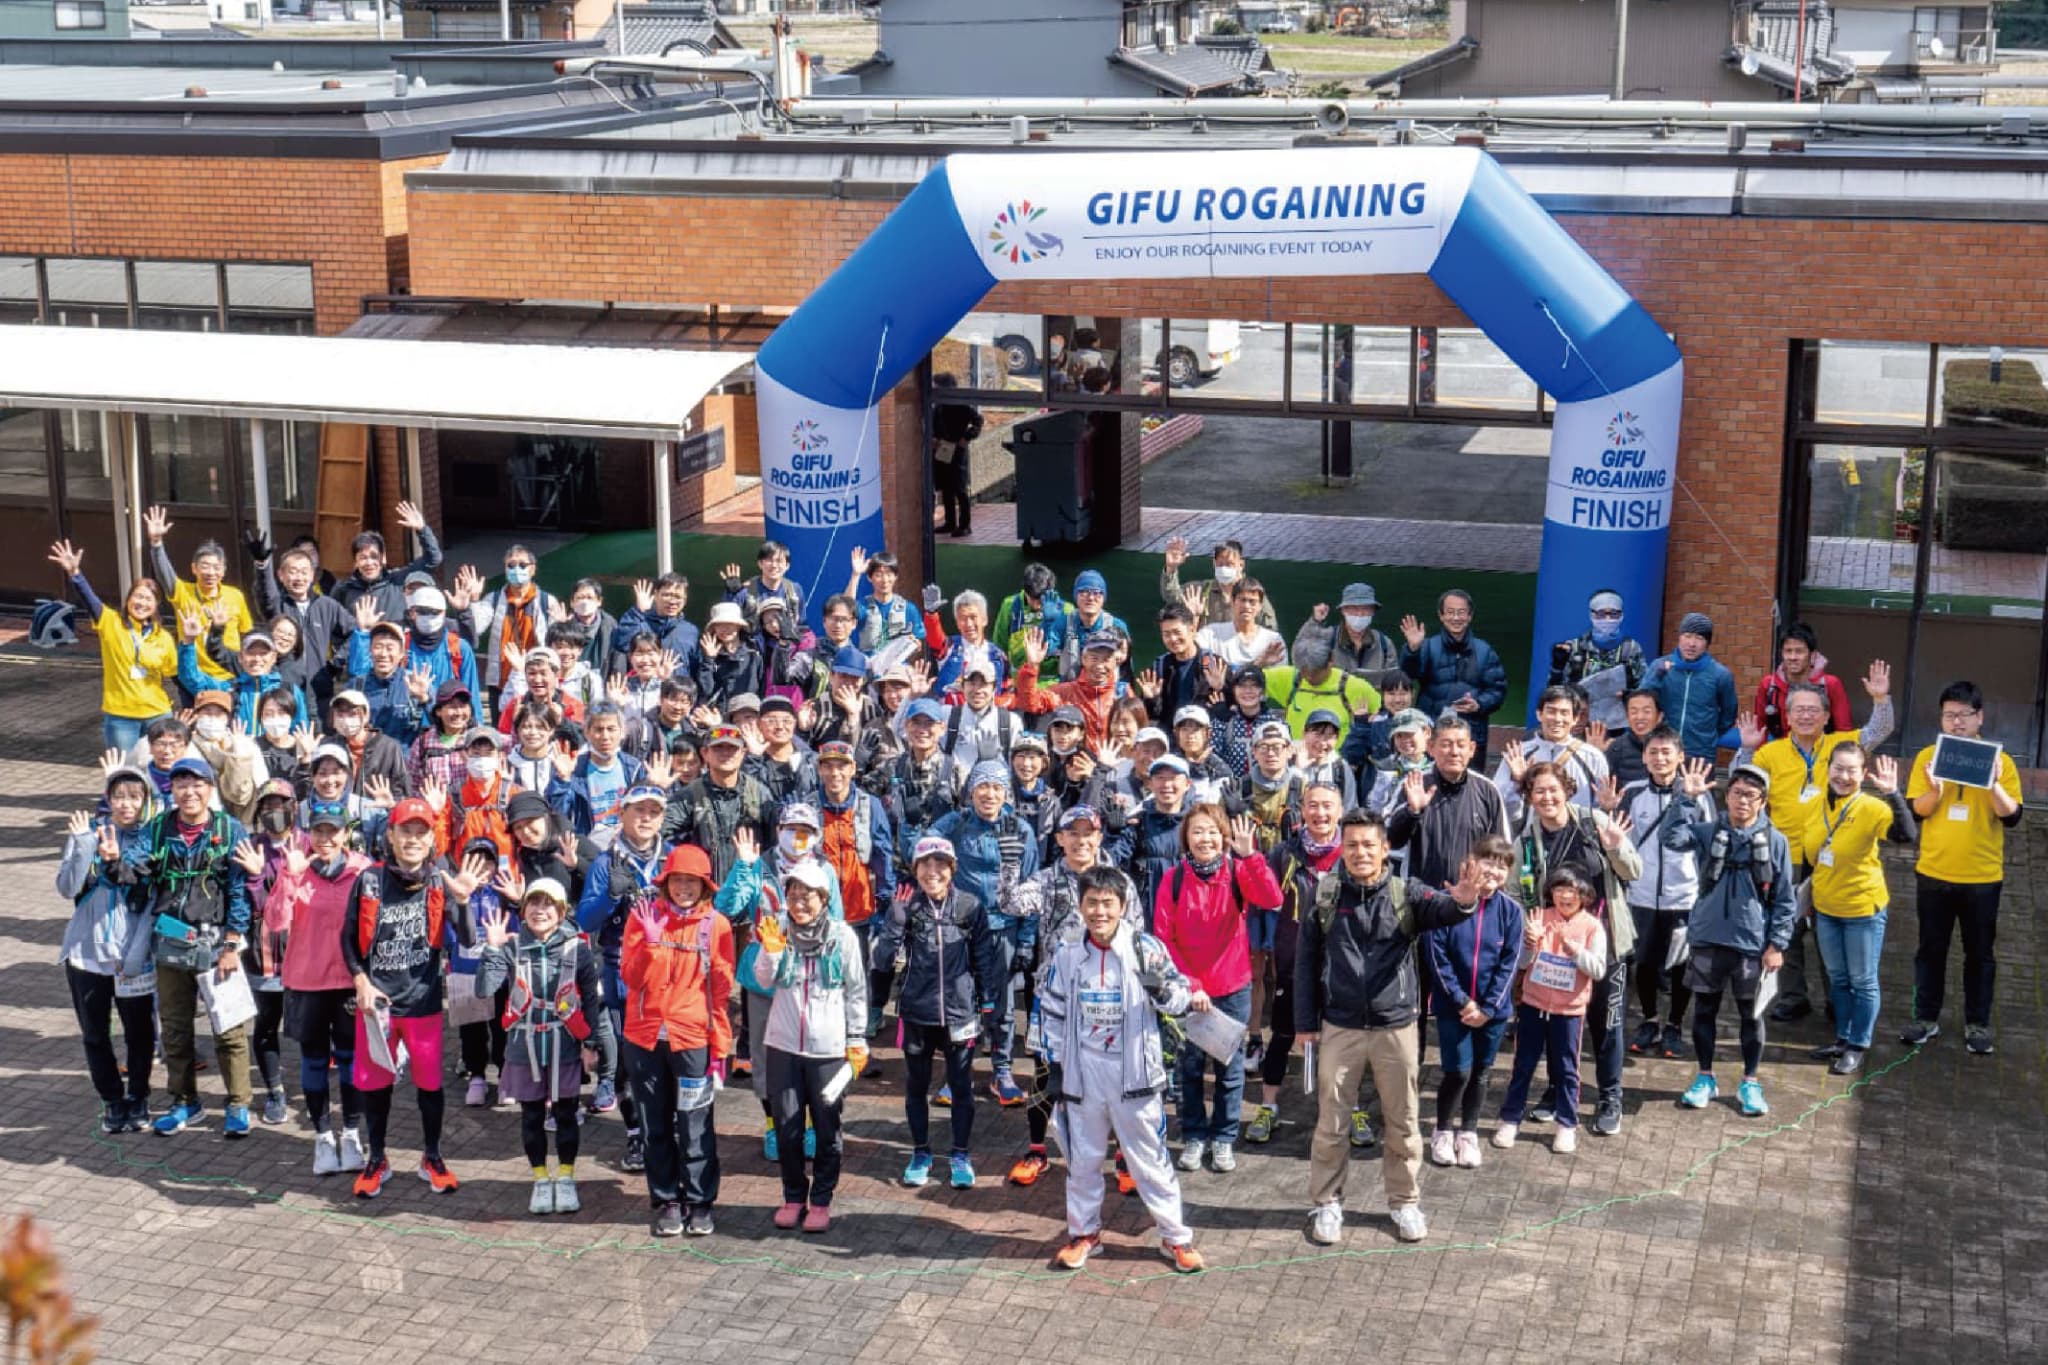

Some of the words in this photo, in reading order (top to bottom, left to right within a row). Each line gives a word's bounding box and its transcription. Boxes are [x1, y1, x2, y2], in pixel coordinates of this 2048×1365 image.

[1087, 188, 1181, 225] GIFU
[1194, 181, 1427, 221] ROGAINING
[1095, 245, 1143, 260] ENJOY
[1146, 244, 1179, 258] OUR
[1182, 242, 1265, 257] ROGAINING
[1269, 241, 1317, 256] EVENT
[1320, 239, 1374, 254] TODAY
[791, 454, 833, 471] GIFU
[1601, 450, 1646, 468] GIFU
[770, 467, 861, 490] ROGAINING
[1571, 466, 1667, 488] ROGAINING
[775, 495, 860, 525] FINISH
[1571, 497, 1662, 528] FINISH
[1606, 963, 1627, 1029] FILA
